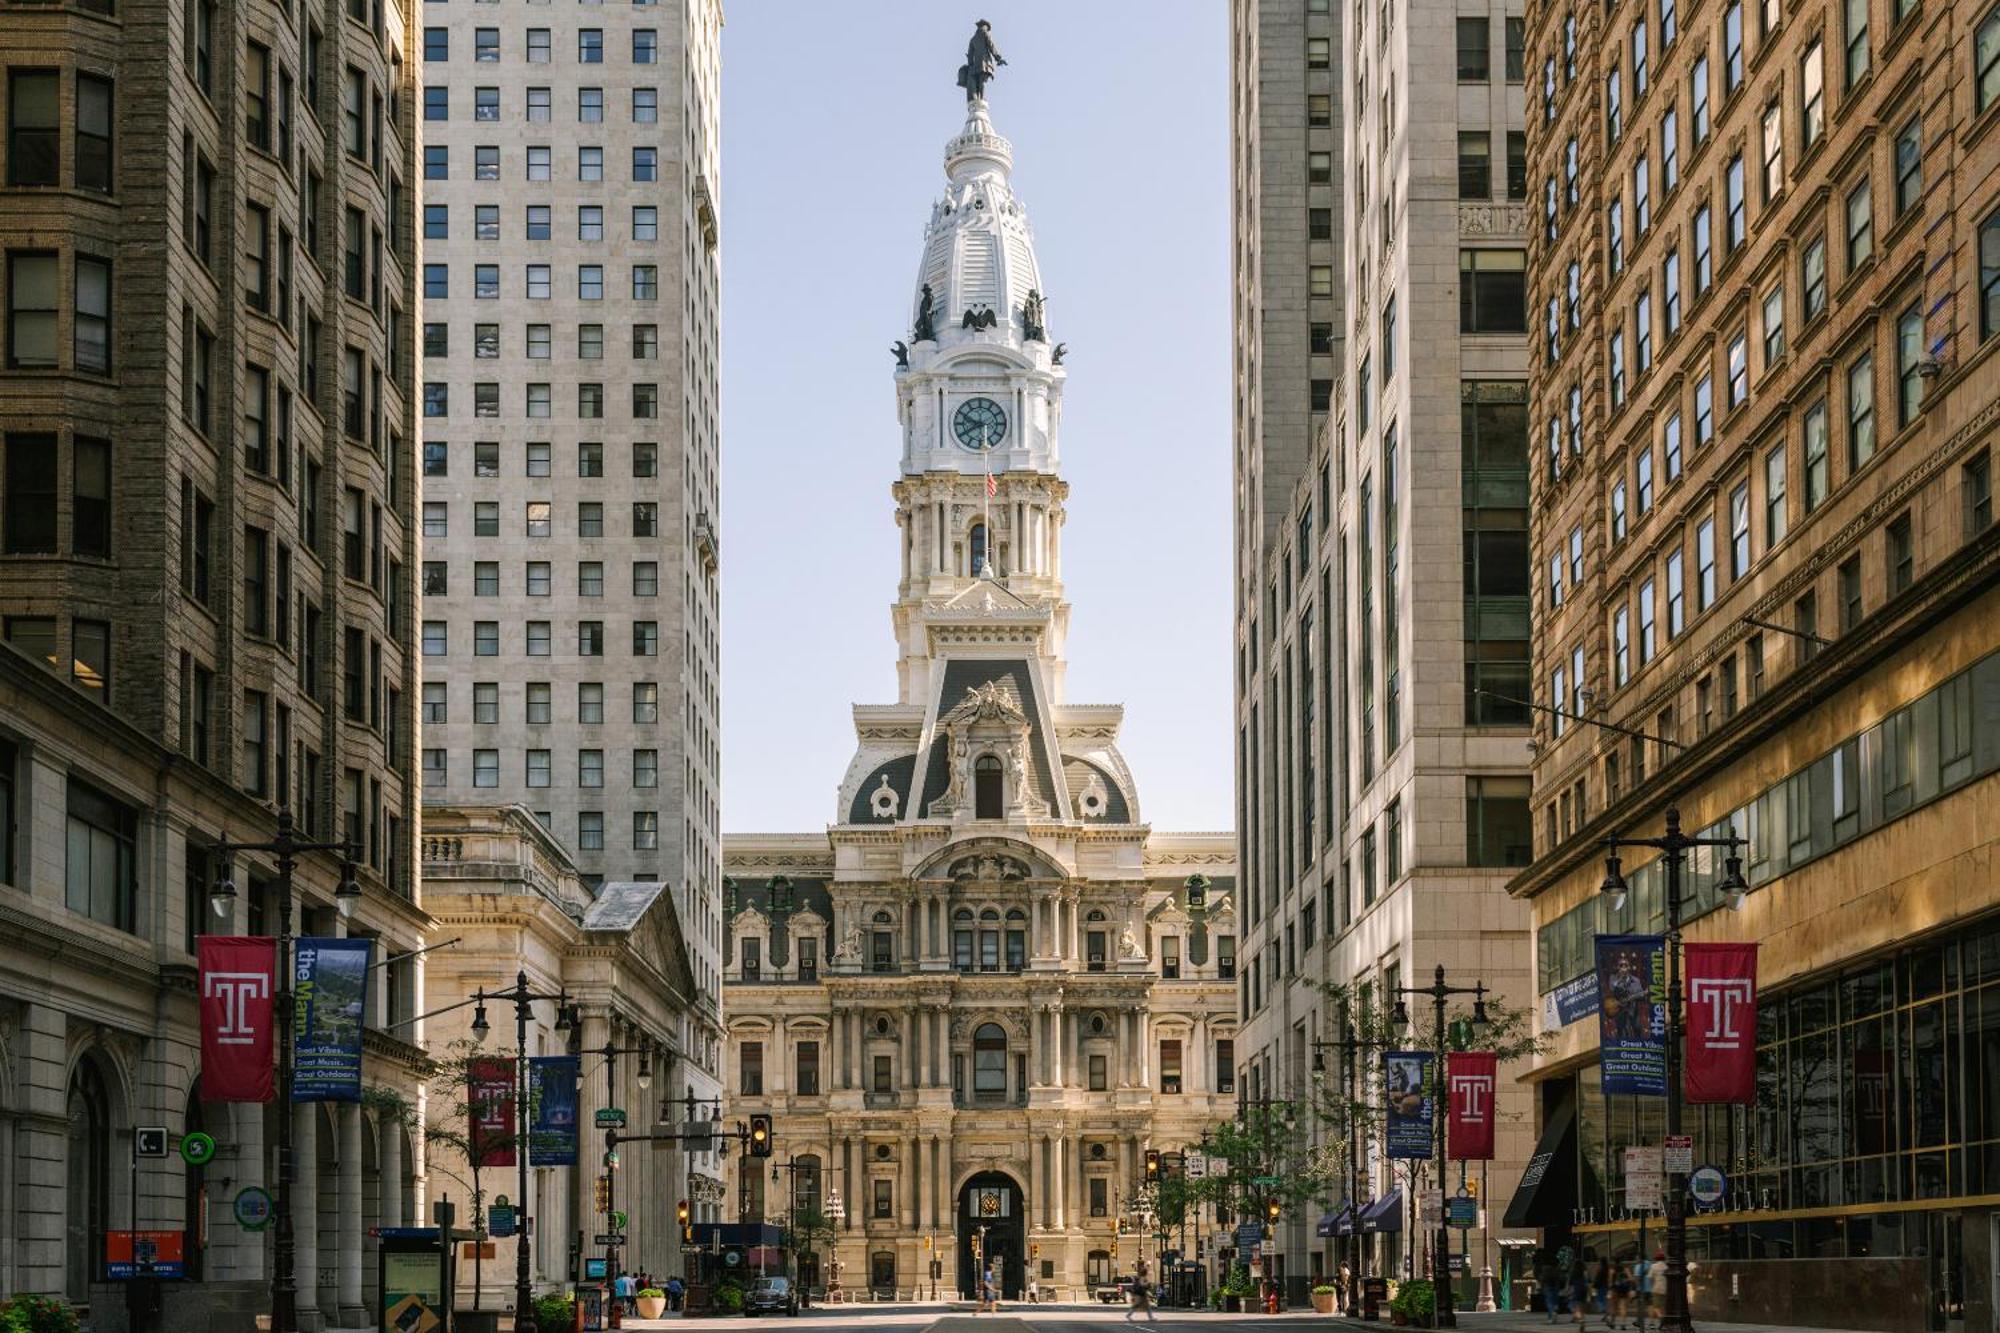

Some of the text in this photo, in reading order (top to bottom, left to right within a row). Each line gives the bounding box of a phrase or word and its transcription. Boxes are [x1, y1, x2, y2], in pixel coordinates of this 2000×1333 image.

[1621, 1040, 1642, 1048] Great
[318, 1046, 345, 1055] Vibes.
[1621, 1051, 1642, 1059] Great
[317, 1058, 345, 1066] Music.
[1606, 1063, 1629, 1071] Great
